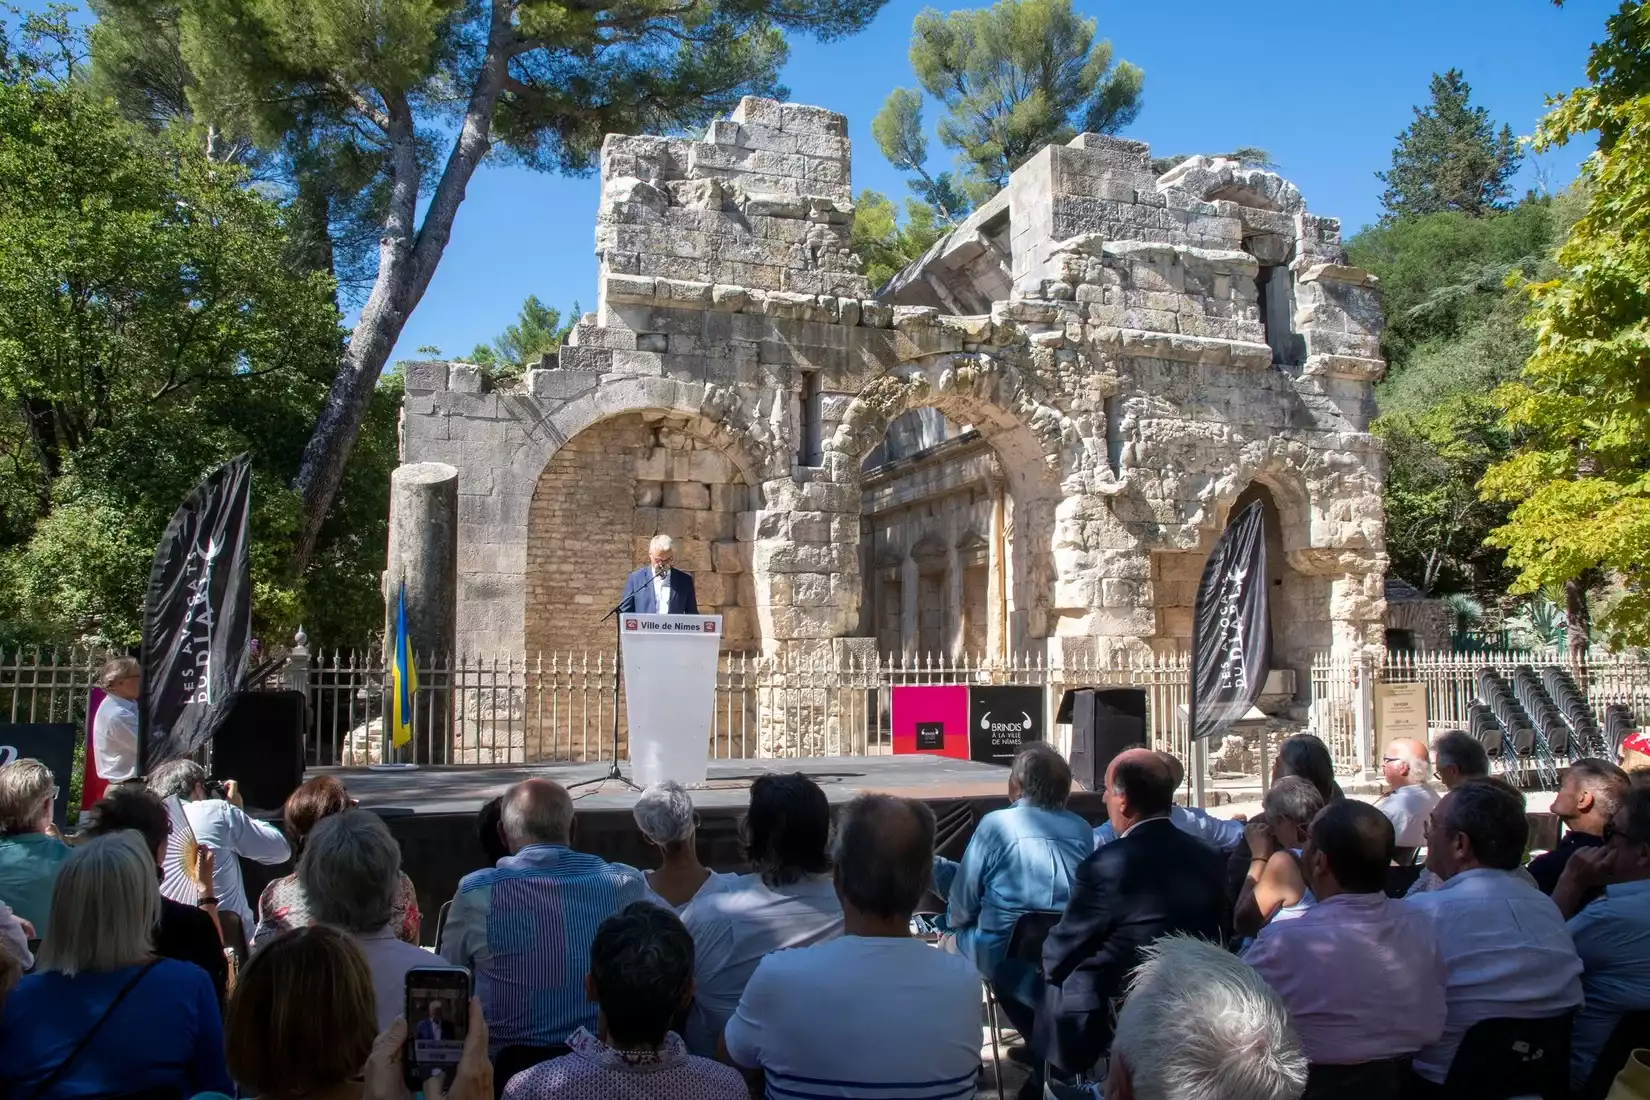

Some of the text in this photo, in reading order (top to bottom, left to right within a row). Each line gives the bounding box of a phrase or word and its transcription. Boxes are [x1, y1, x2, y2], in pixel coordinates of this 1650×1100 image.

[180, 551, 198, 704] LES AVOCATS
[641, 622, 660, 630] Ville
[662, 621, 673, 630] de
[1221, 661, 1232, 689] LES
[1234, 667, 1246, 688] DU
[197, 674, 209, 703] DU
[991, 722, 1022, 732] BRINDIS
